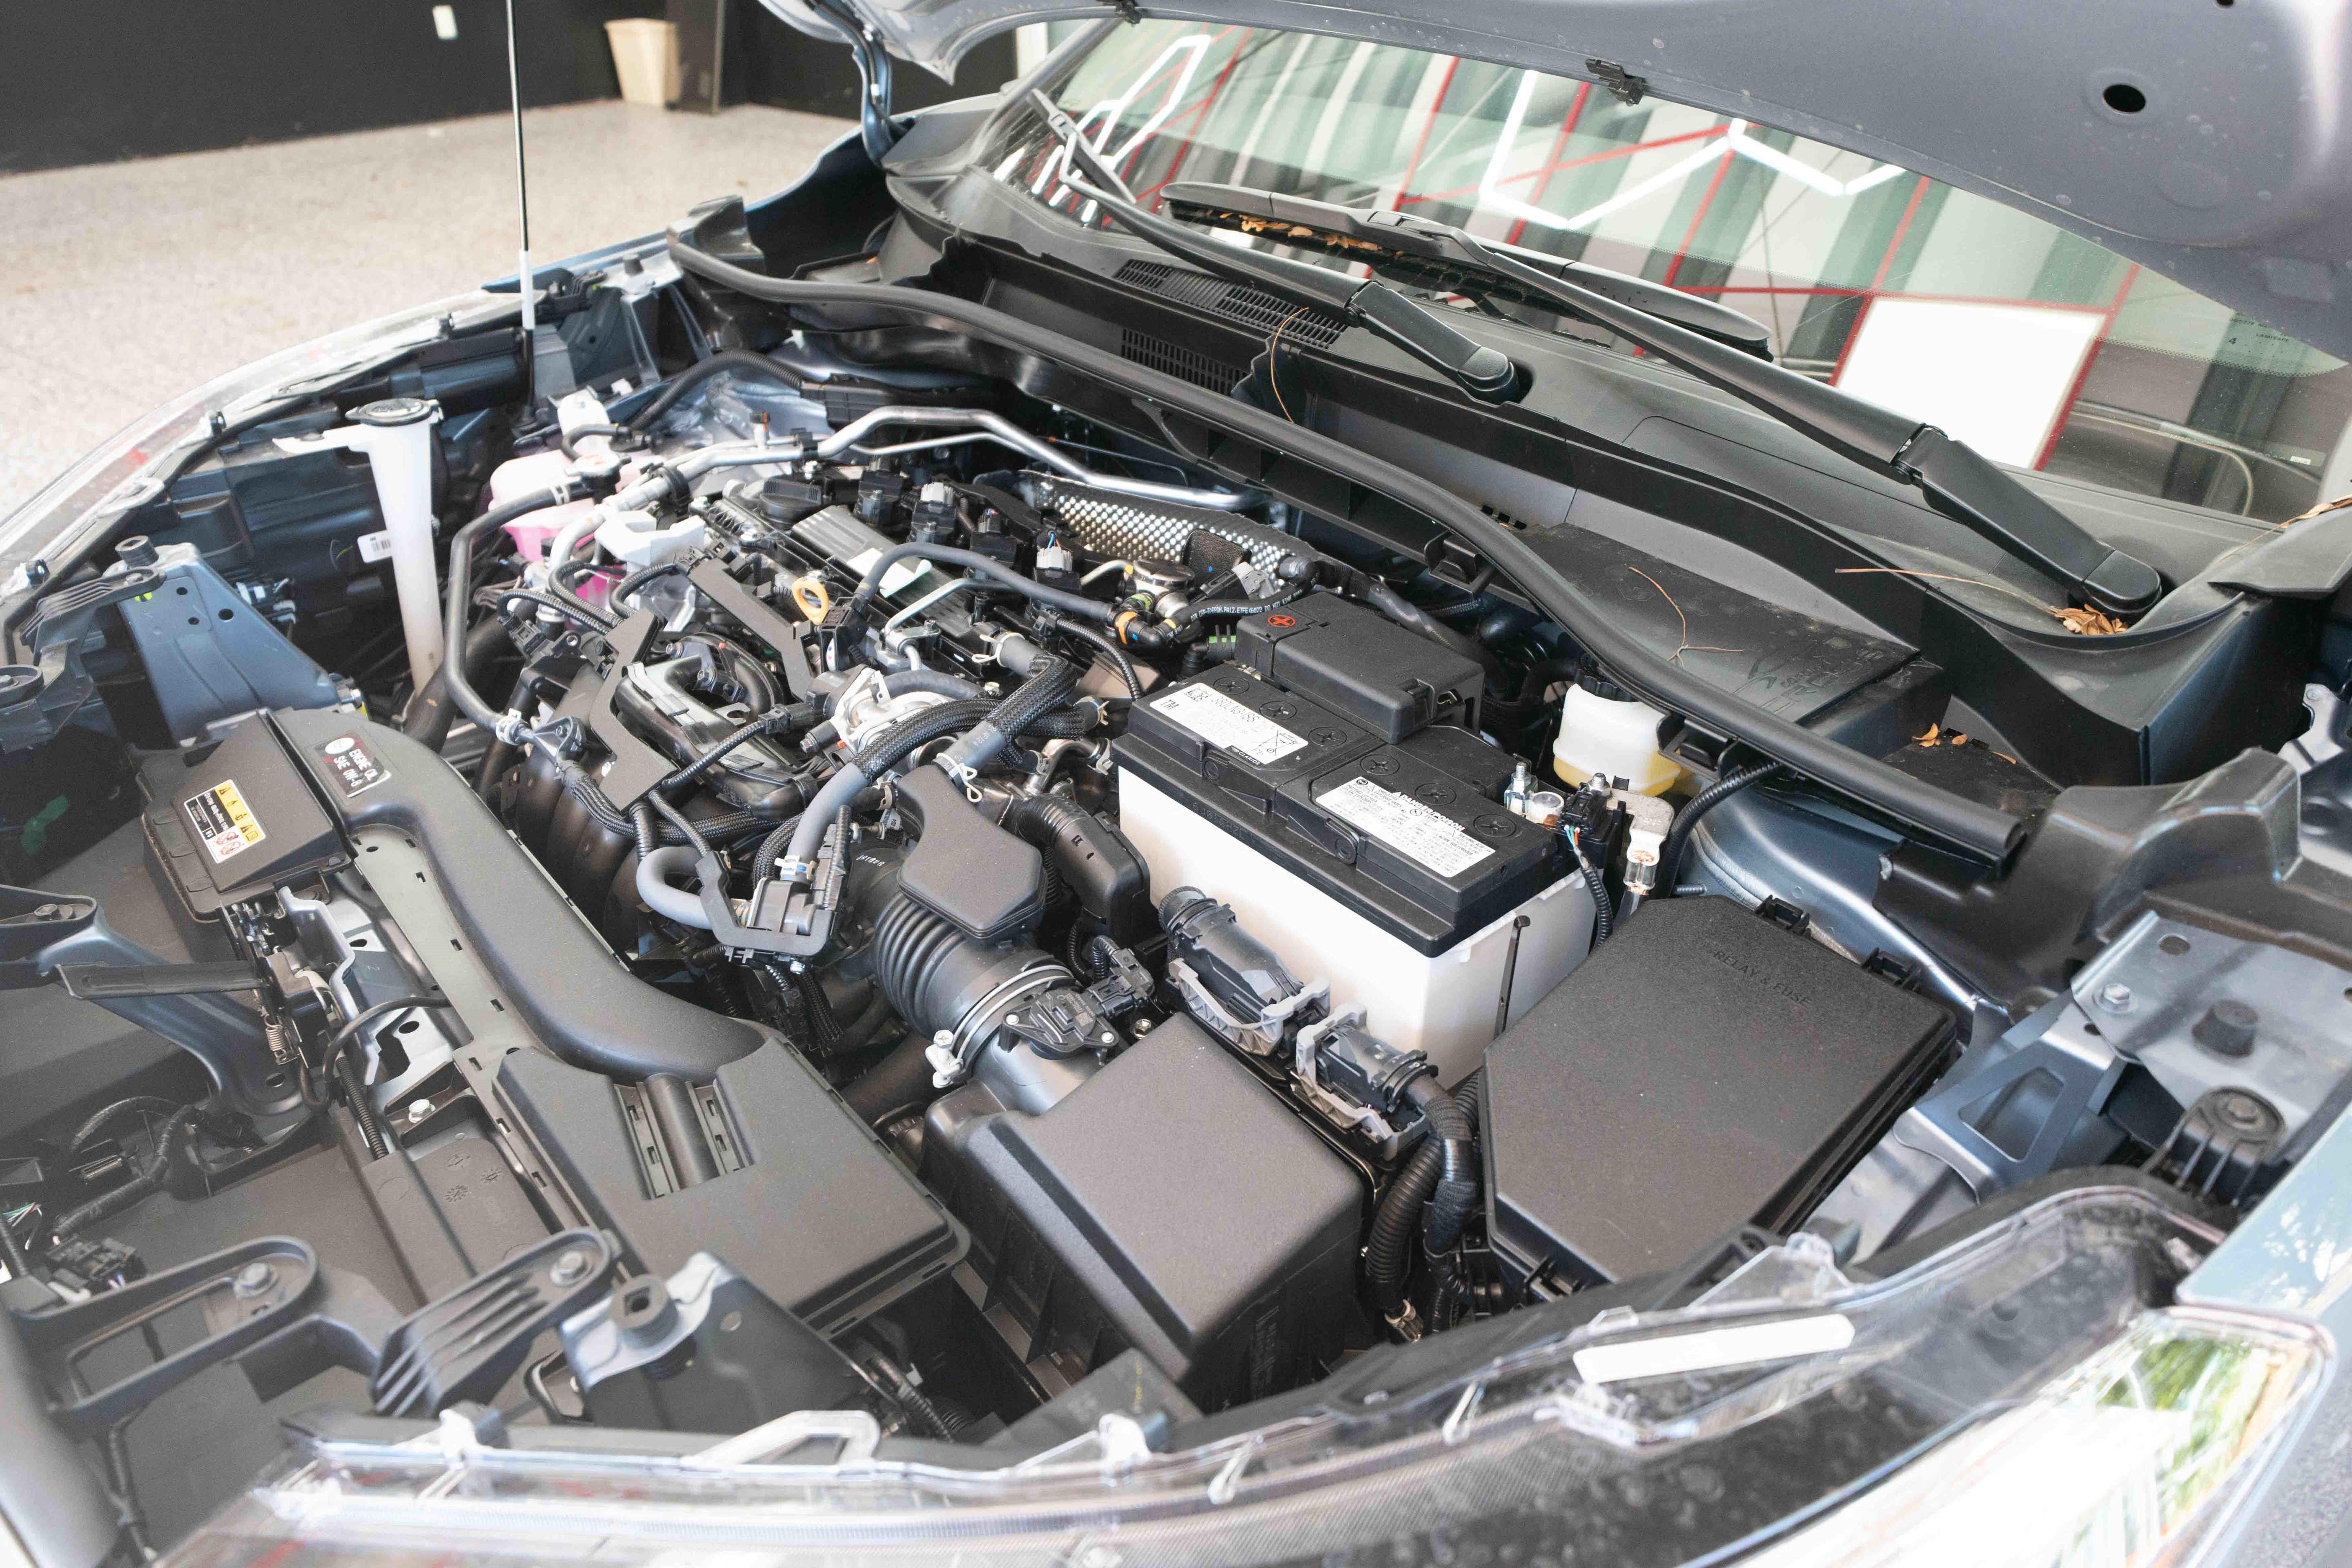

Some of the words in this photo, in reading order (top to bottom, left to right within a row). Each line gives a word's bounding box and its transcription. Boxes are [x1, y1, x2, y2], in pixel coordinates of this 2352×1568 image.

[1160, 699, 1179, 710] TM
[333, 755, 350, 770] SAE
[349, 748, 371, 770] ENGINE
[364, 769, 378, 781] OIL
[1238, 752, 1261, 765] CLARIOS
[1714, 951, 1760, 977] RELAY
[1773, 982, 1813, 1005] FUSE
